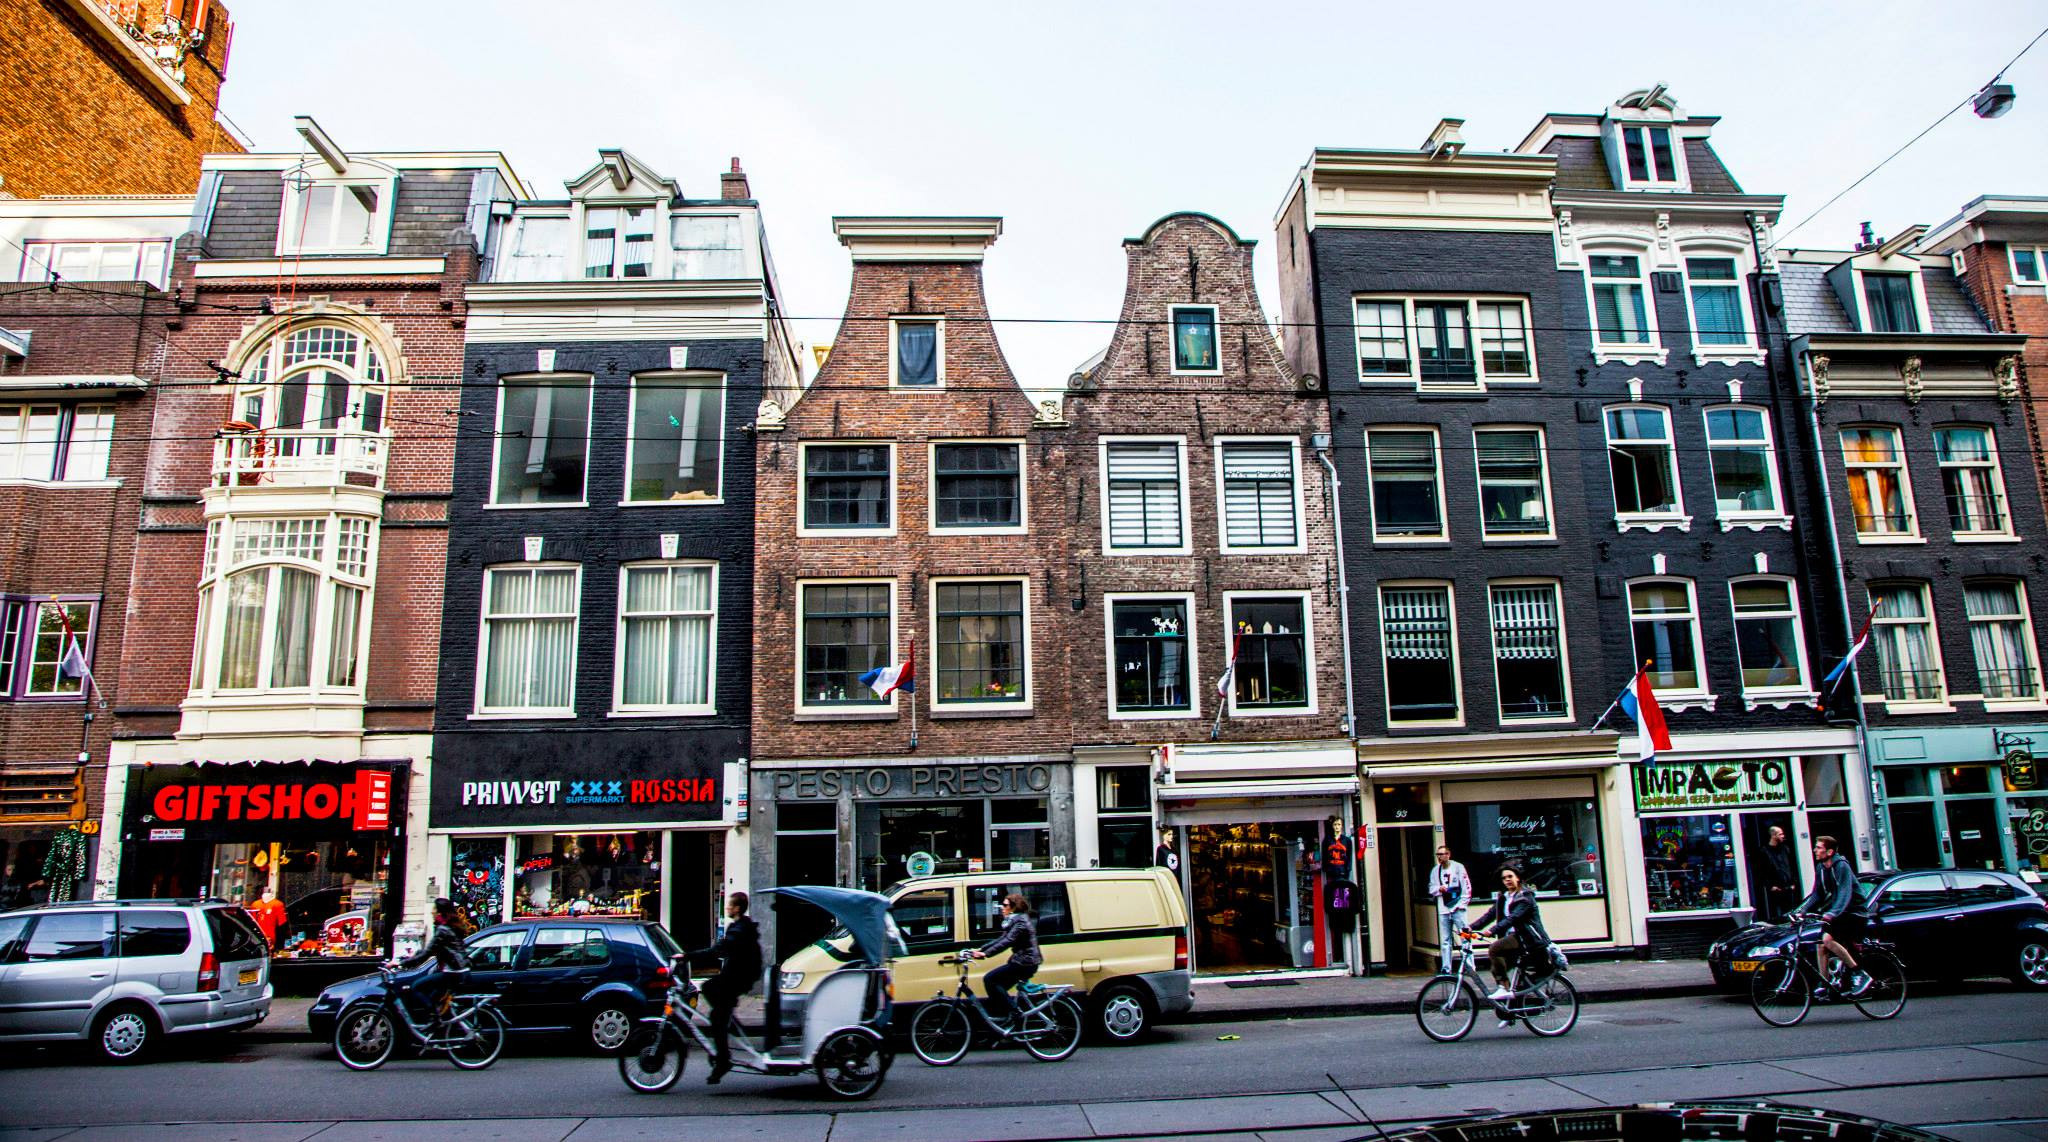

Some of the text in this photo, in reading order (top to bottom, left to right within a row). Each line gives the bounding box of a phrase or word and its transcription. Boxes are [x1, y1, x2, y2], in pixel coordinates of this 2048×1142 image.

[773, 764, 1053, 798] PESTO PRESTO
[1637, 761, 1784, 797] IMPACTO
[462, 780, 561, 805] PRIWET
[630, 778, 715, 804] ROSSIA
[565, 795, 626, 804] SUPERMARKT
[1395, 809, 1408, 818] 93
[1497, 815, 1546, 833] Cindy's
[523, 858, 552, 870] OPEN
[1052, 855, 1067, 870] 89
